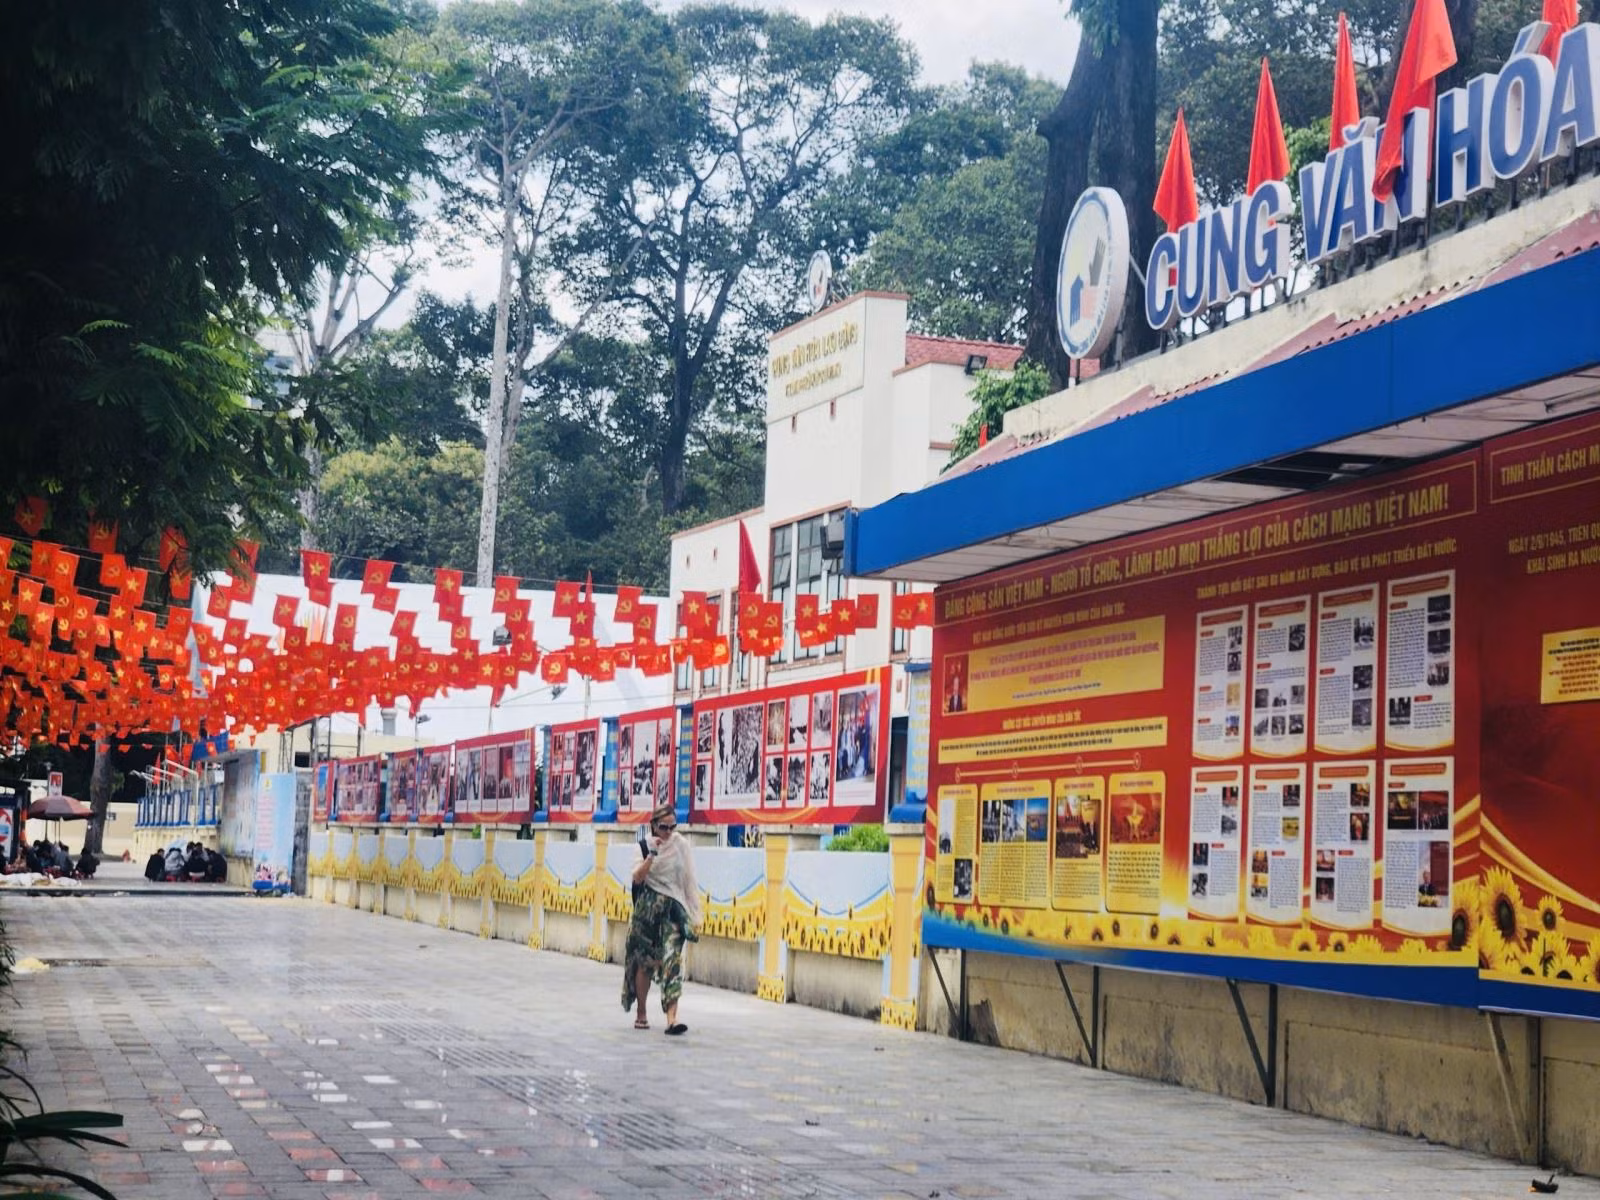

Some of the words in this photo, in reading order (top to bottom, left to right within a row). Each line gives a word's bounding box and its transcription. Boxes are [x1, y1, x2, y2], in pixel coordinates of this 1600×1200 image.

[1145, 180, 1288, 330] CUNG
[1300, 117, 1428, 264] VĂN
[1436, 20, 1600, 208] HÓA
[1501, 464, 1524, 486] TINH
[1526, 451, 1554, 480] THẦN
[1557, 448, 1586, 473] CÁCH
[1179, 540, 1200, 569] MỌI
[1203, 527, 1240, 559] THẮNG
[1264, 514, 1290, 546] CỦA
[1293, 511, 1327, 541] CÁCH
[1331, 501, 1371, 537] MẠNG
[1375, 491, 1404, 529] VIỆT
[1408, 482, 1449, 518] NAM!
